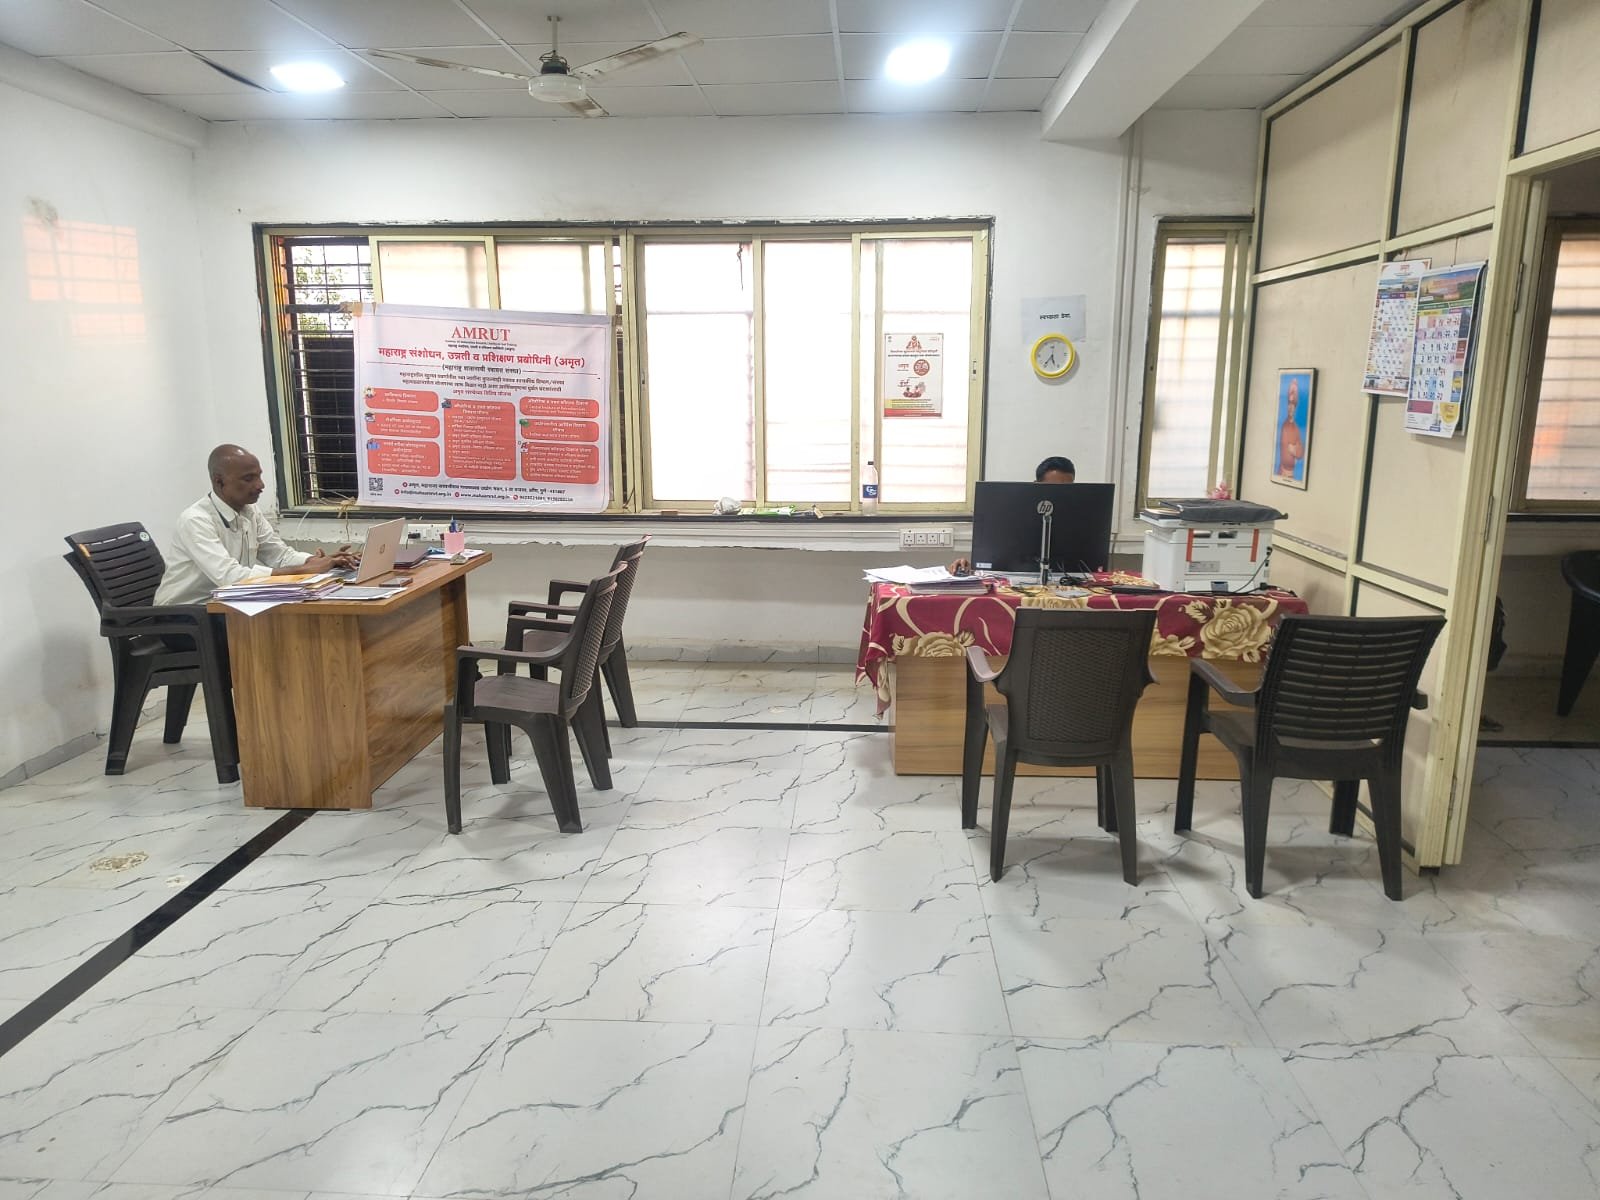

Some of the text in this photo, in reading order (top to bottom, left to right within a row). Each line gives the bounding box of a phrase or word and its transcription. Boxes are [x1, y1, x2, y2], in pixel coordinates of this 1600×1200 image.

[451, 326, 511, 342] AMRUT
[378, 347, 407, 359] महाराष्ट्र
[409, 347, 445, 361] संशोधन,
[447, 351, 470, 361] उन्नती
[473, 353, 480, 361] व
[482, 351, 514, 364] प्रशिक्षण
[517, 354, 551, 365] प्रबोधिनी
[554, 356, 585, 369] (अमृत)
[1039, 500, 1052, 516] hp
